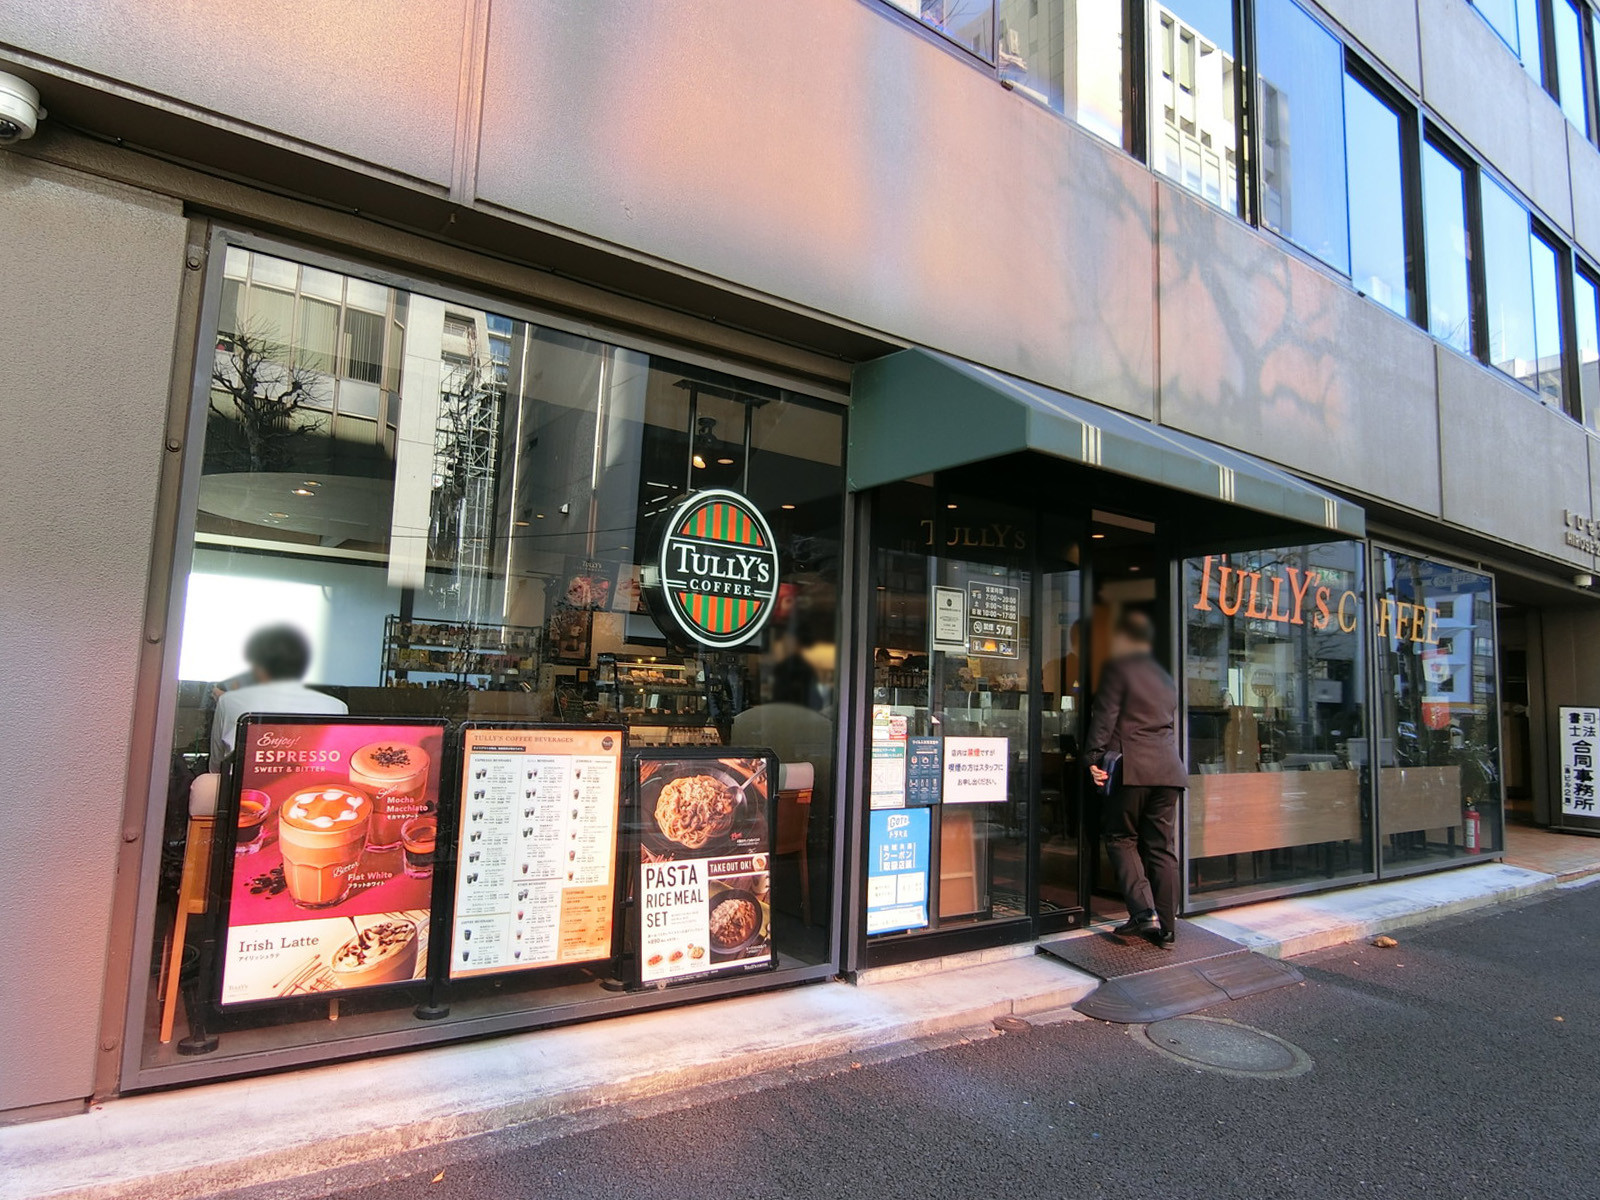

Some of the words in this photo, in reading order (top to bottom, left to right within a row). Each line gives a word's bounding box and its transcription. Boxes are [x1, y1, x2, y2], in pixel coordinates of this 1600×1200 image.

[672, 543, 769, 583] TULLY'S
[689, 579, 752, 596] COFFEE
[1338, 591, 1441, 645] CFFEE
[256, 732, 301, 749] Enjoy!
[255, 750, 341, 763] ESPRESSO
[951, 748, 996, 757] 店内は禁煙ですが
[295, 765, 326, 773] BITTER
[948, 763, 1004, 772] 喫煙の方はスタッフに
[957, 778, 997, 786] お申し出ください。
[1572, 740, 1595, 811] 合同事務所
[386, 796, 415, 804] Mocha
[386, 804, 429, 813] Macchiato
[883, 850, 913, 860] クーポン
[709, 863, 726, 873] TAKE
[726, 862, 738, 872] OUT
[740, 861, 752, 870] OK!
[347, 872, 365, 881] Flat
[367, 871, 393, 879] White
[646, 864, 698, 889] PASTA
[646, 892, 672, 909] RICE
[674, 889, 704, 906] MEAL
[646, 911, 668, 928] SET
[239, 939, 274, 952] Irish
[281, 936, 320, 949] Latte
